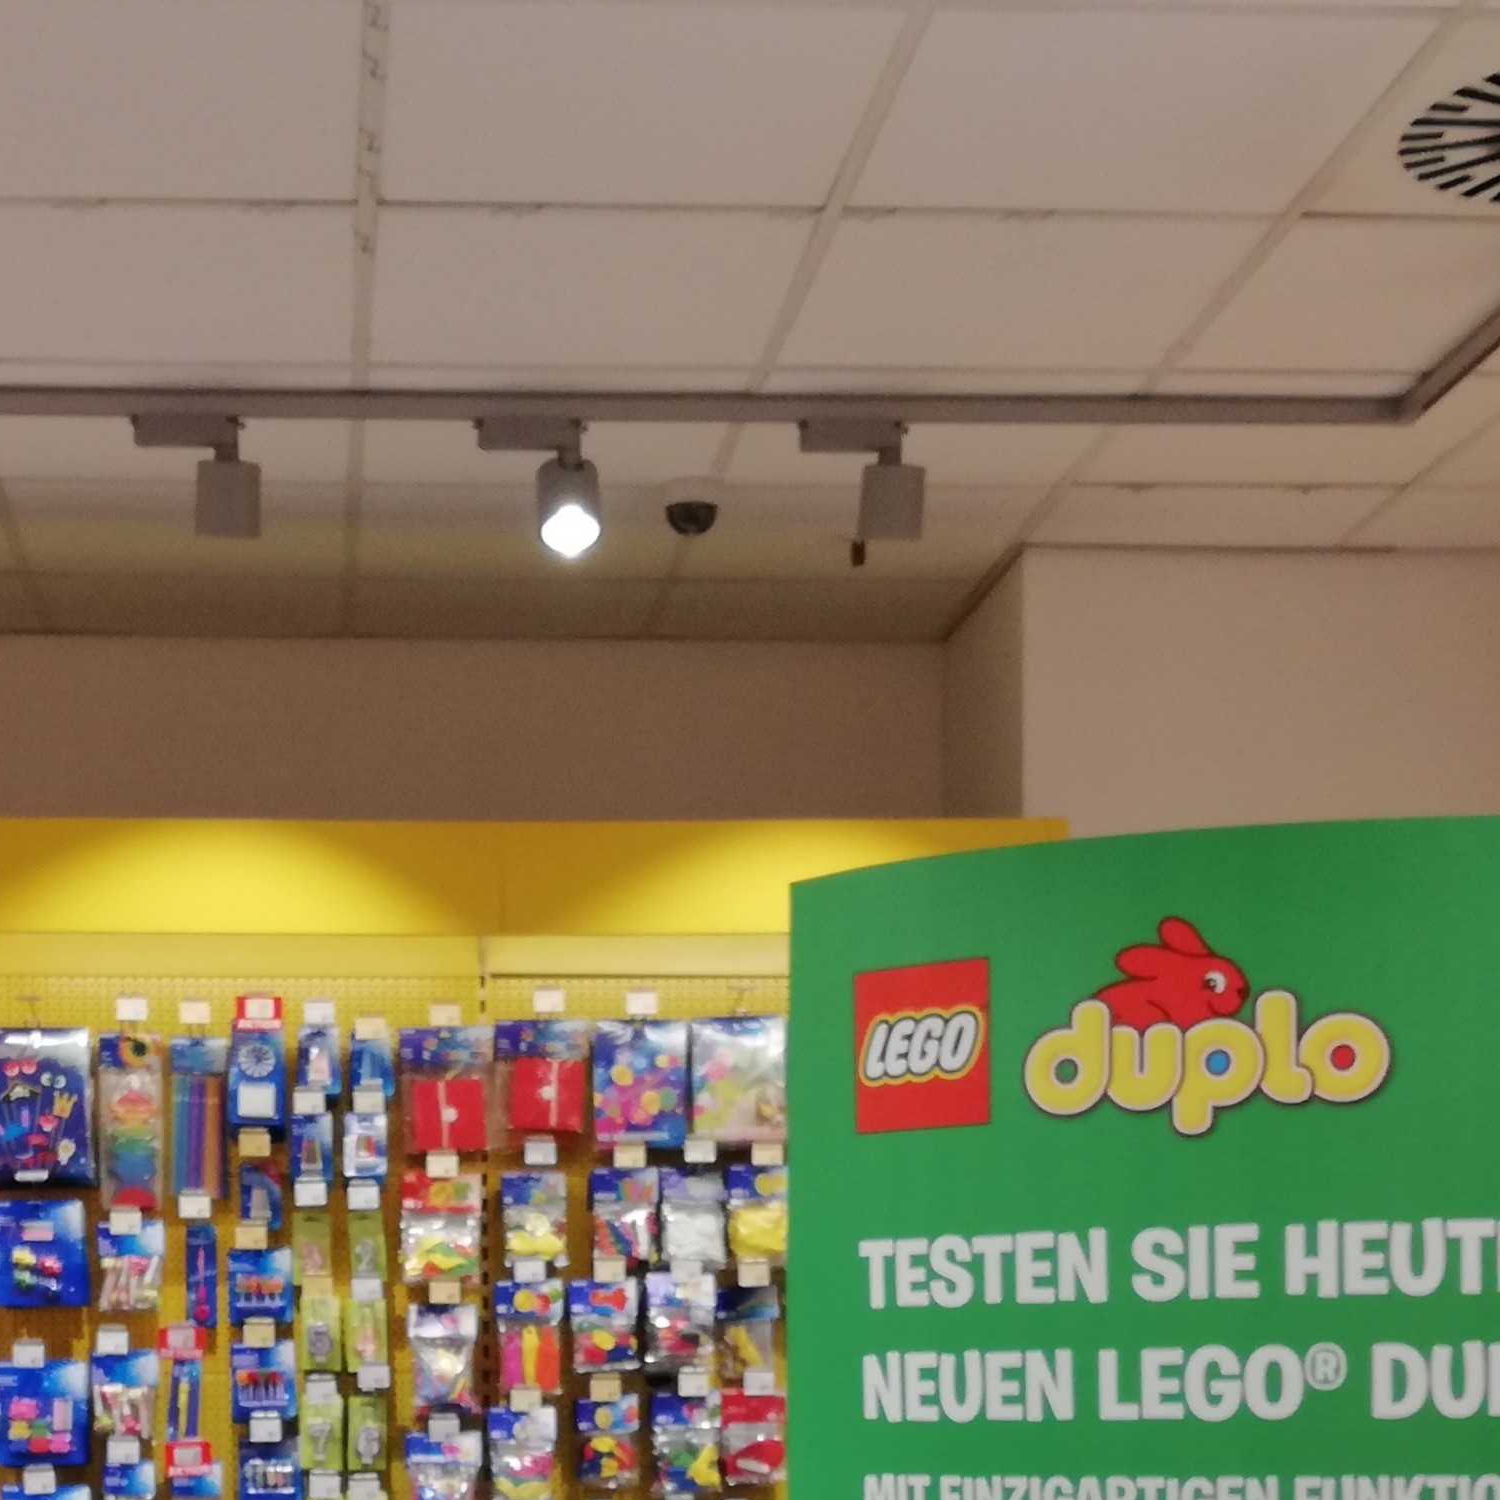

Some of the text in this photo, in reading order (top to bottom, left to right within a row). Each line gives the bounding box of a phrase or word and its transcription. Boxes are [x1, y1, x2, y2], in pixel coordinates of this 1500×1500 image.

[863, 1010, 979, 1081] LEGO
[1024, 990, 1391, 1136] duplo
[858, 1218, 1500, 1309] TESTEN SIE HEUT
[862, 1348, 1074, 1423] NEUEN
[1098, 1341, 1348, 1422] LEGO®
